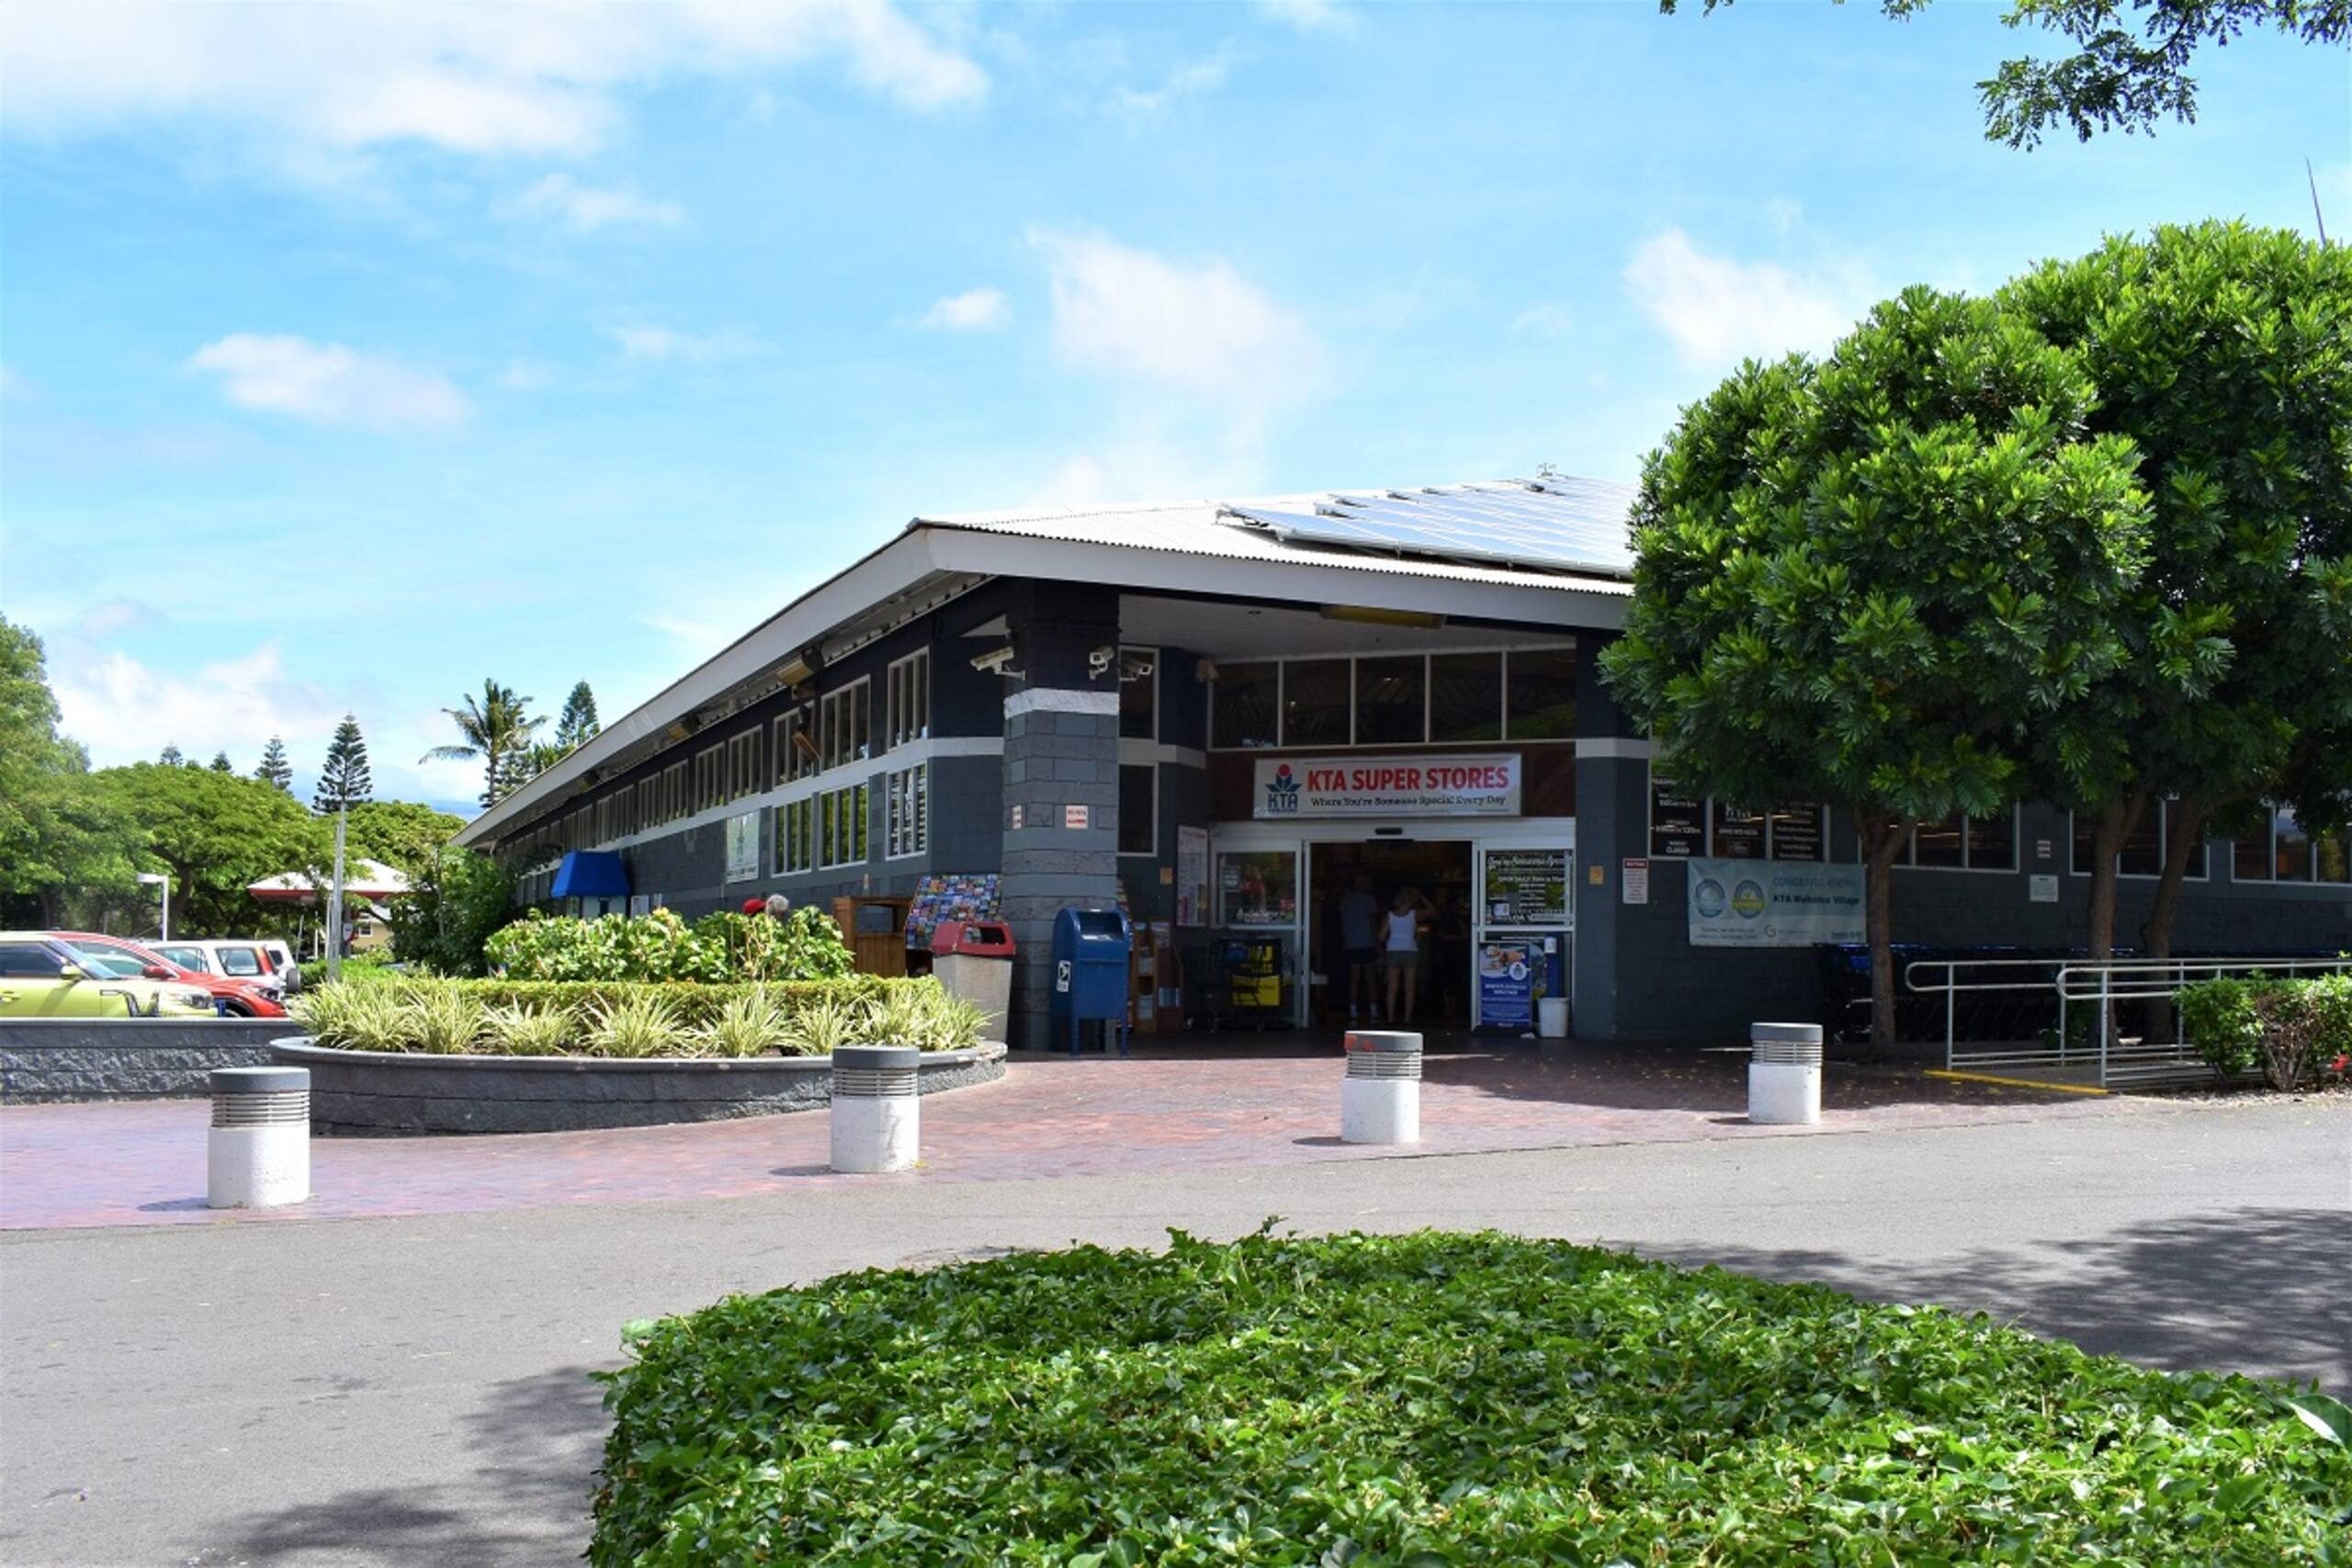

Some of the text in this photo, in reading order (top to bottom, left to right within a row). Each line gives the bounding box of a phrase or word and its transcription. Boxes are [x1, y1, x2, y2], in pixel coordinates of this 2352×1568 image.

[1307, 766, 1510, 792] KTA SUPER STORES
[1268, 793, 1298, 808] KTA
[1310, 795, 1507, 807] Where You're Someone Special Every Day
[1772, 895, 1792, 904] KTA
